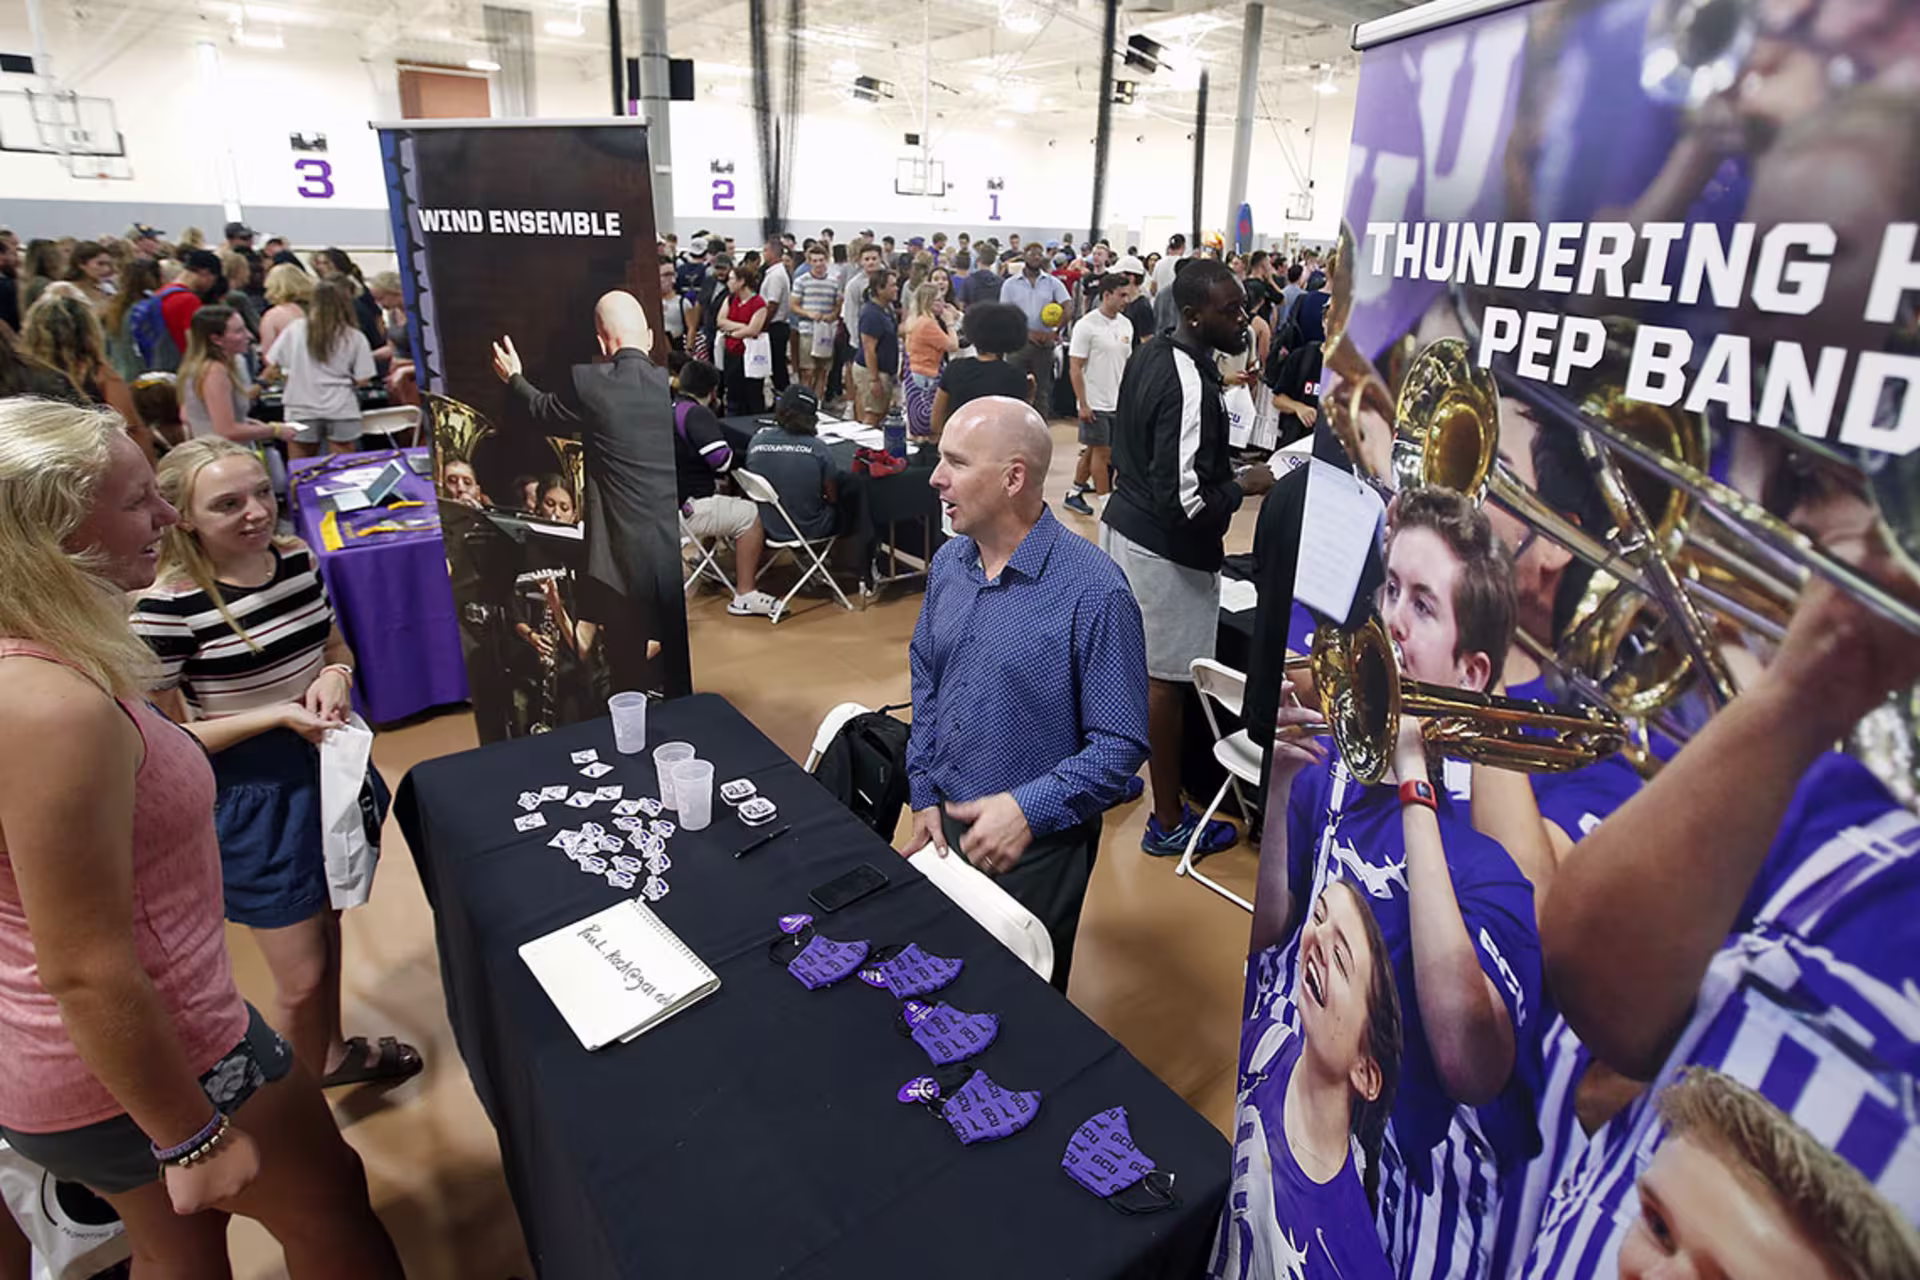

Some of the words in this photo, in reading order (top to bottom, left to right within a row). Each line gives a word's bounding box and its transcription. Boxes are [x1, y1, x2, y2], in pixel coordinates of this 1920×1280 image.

[295, 159, 334, 199] 3
[712, 179, 735, 211] 2
[988, 194, 1001, 221] 1
[418, 209, 483, 232] WIND
[488, 210, 621, 236] ENSEMBLE
[1366, 222, 1837, 315] THUNDERING
[1478, 306, 1607, 386] PEP
[1625, 325, 1920, 455] BAND
[931, 1016, 950, 1035] GCU
[960, 1026, 980, 1044] GCU
[934, 1040, 953, 1059] GCU
[983, 1078, 1002, 1099] GCU
[1009, 1092, 1030, 1114] GCU
[981, 1106, 1000, 1128] GCU
[1110, 1131, 1137, 1152] GCU
[1091, 1154, 1119, 1175] GCU
